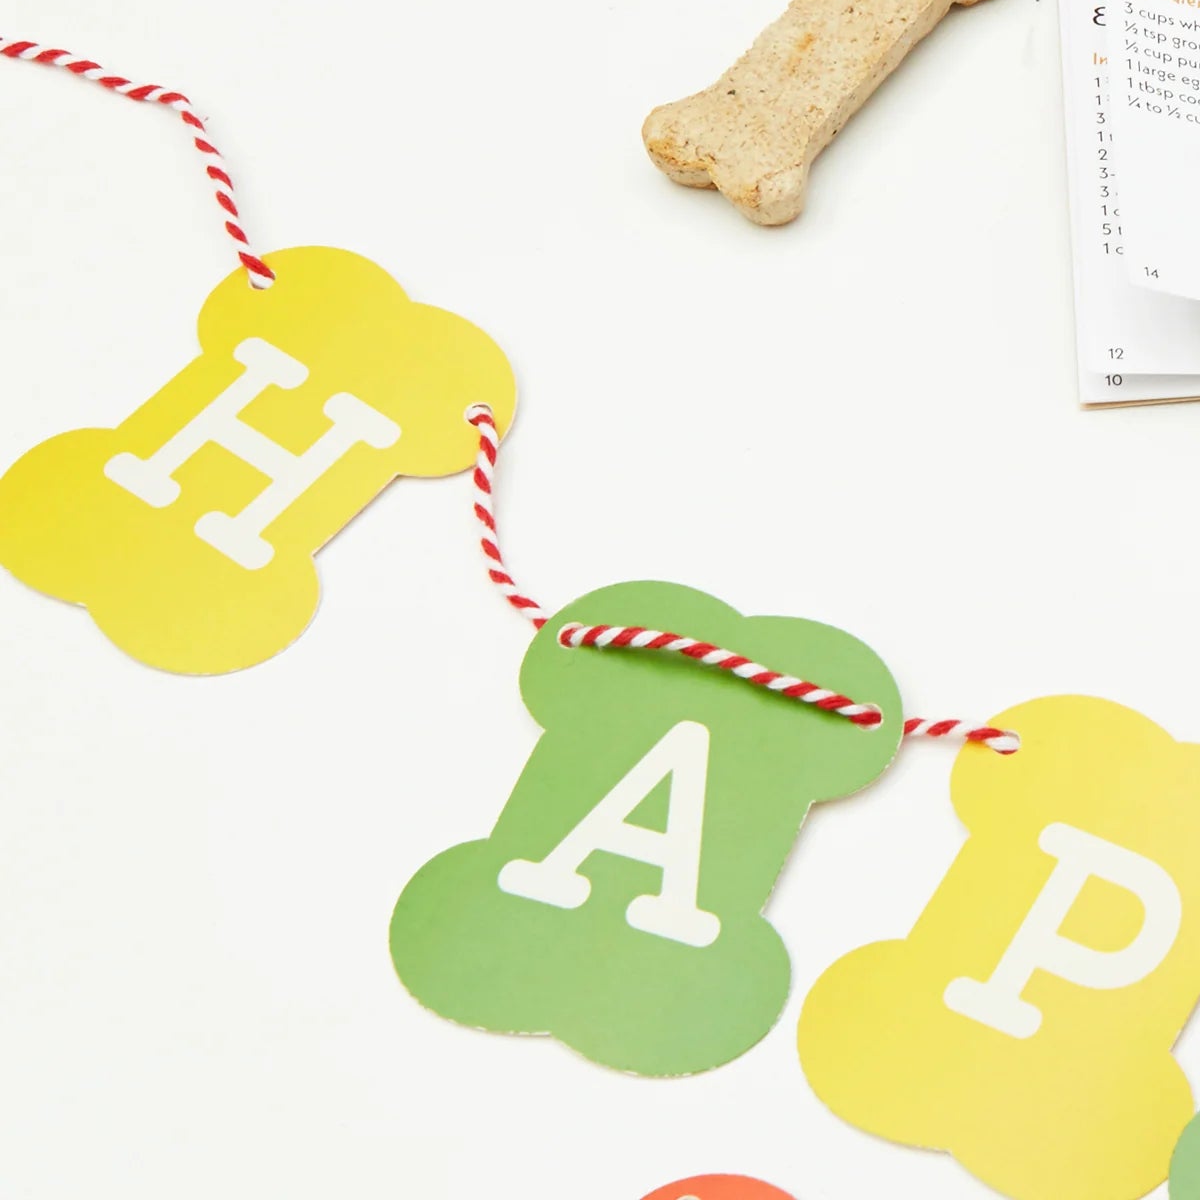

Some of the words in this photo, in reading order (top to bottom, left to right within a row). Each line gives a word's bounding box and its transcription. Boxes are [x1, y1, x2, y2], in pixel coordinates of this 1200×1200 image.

[1124, 1, 1134, 15] 3
[1138, 9, 1175, 26] cups
[1143, 28, 1167, 44] tsp
[1143, 48, 1173, 64] cup
[1126, 58, 1132, 70] 1
[1137, 60, 1176, 82] large
[1127, 76, 1133, 89] 1
[1138, 80, 1174, 101] tbsp
[1146, 101, 1162, 114] to
[1144, 266, 1159, 279] 14
[1108, 347, 1124, 360] 12
[1104, 373, 1123, 387] 10
[102, 334, 404, 570] H
[494, 720, 722, 948] A
[942, 820, 1184, 1040] P
